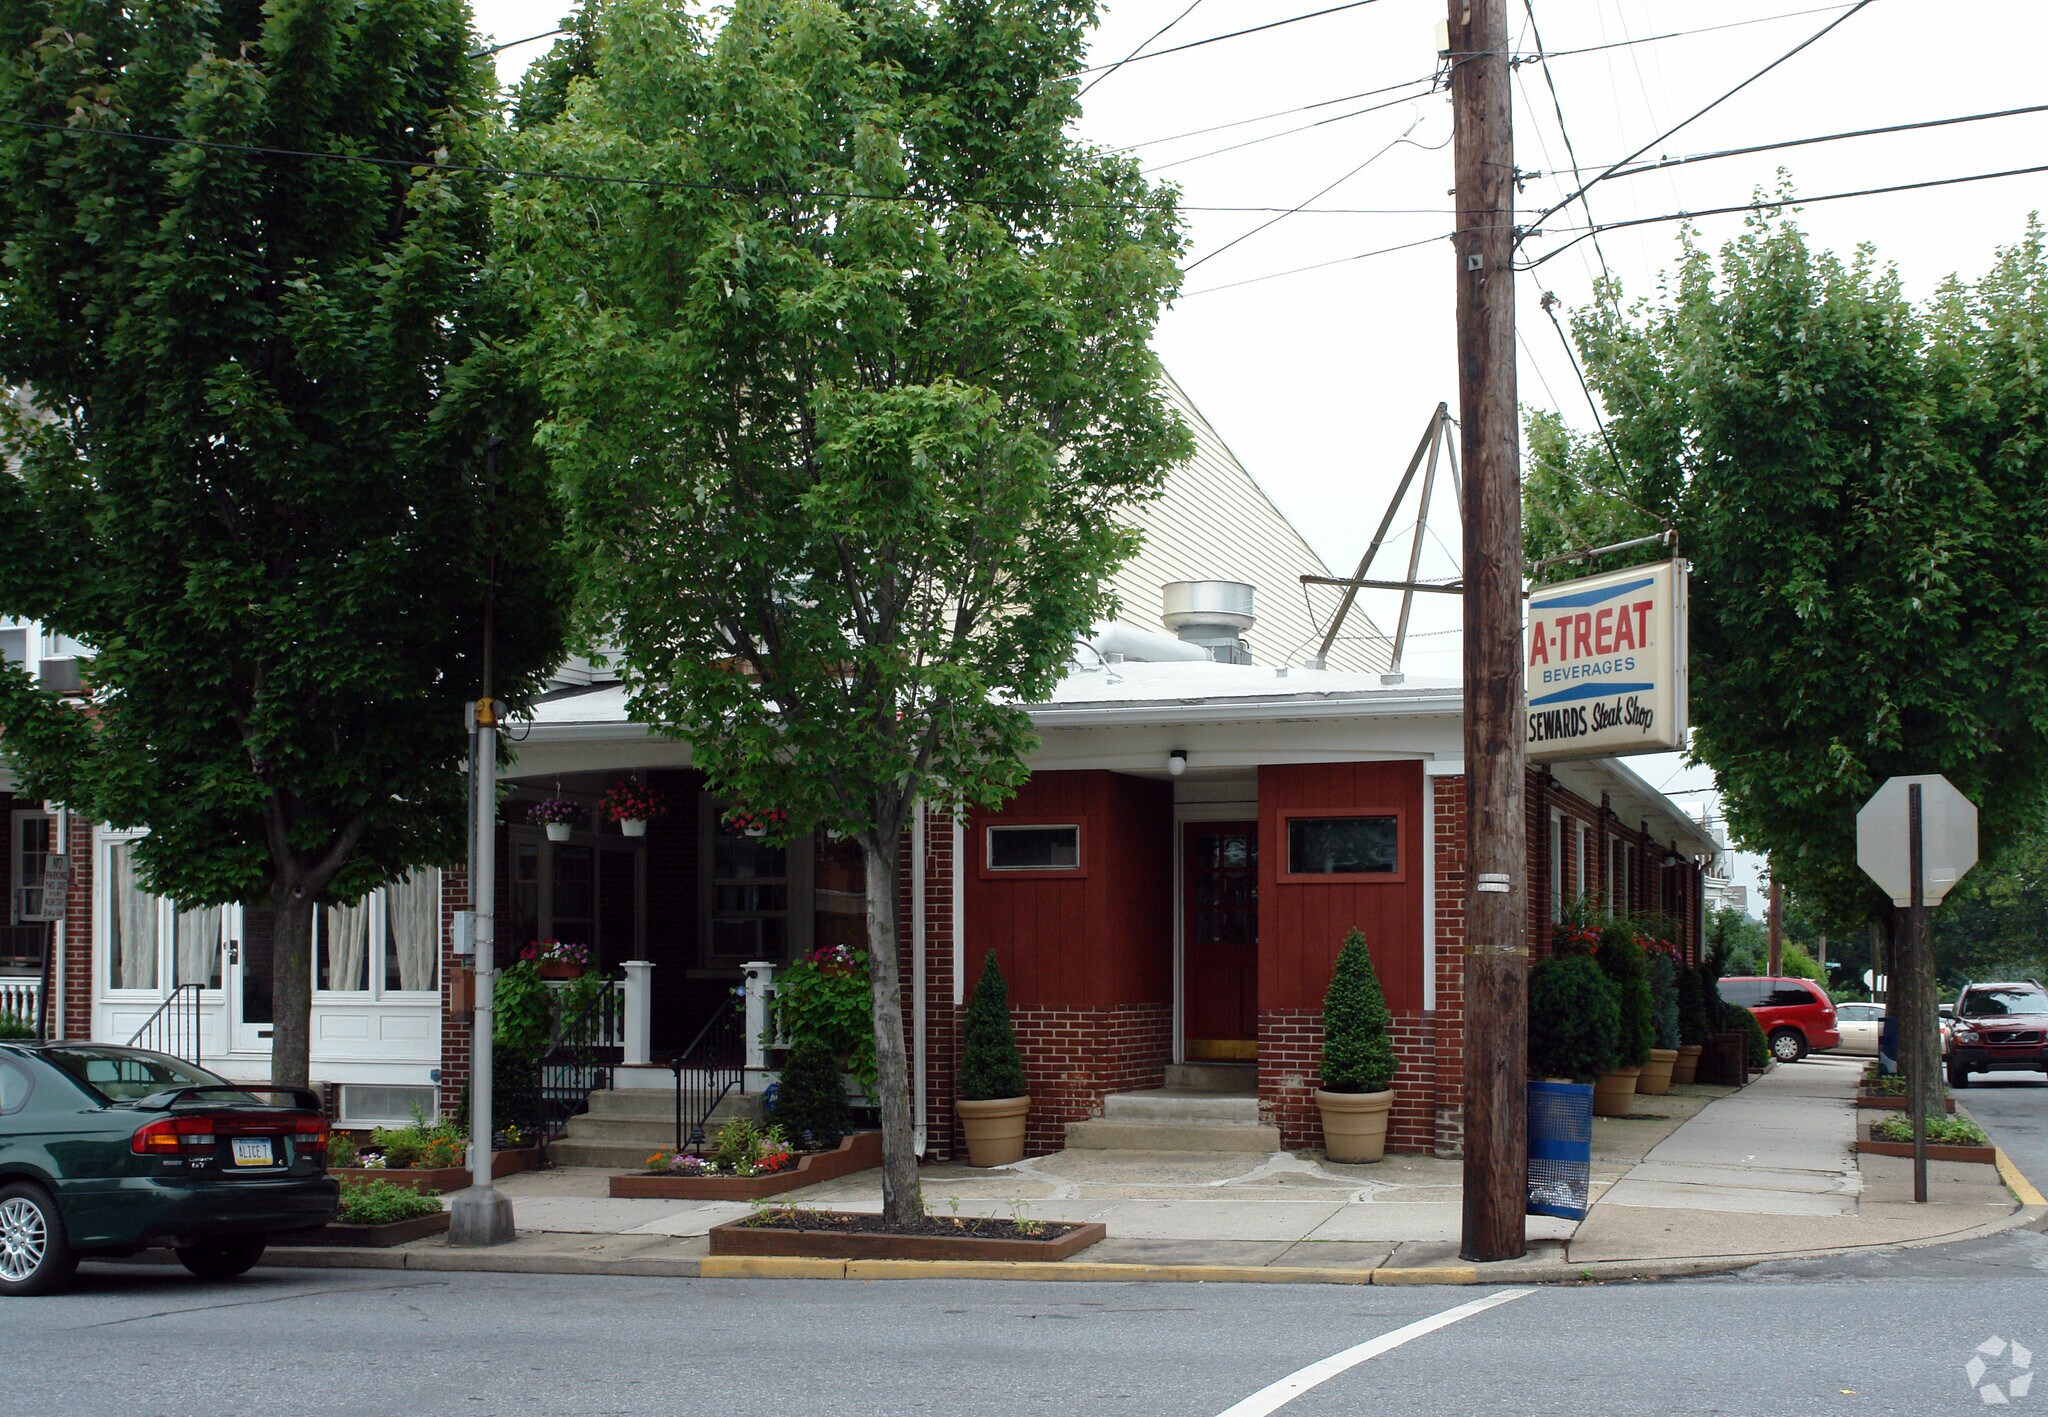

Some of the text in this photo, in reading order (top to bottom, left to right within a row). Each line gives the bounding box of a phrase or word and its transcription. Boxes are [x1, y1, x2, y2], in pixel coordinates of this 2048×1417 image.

[1543, 657, 1635, 683] BEVERAGES
[1528, 695, 1653, 742] SEWARDS Steak Shop
[52, 857, 63, 870] NO
[45, 871, 68, 880] PARKING
[239, 1144, 268, 1159] ALICE 7
